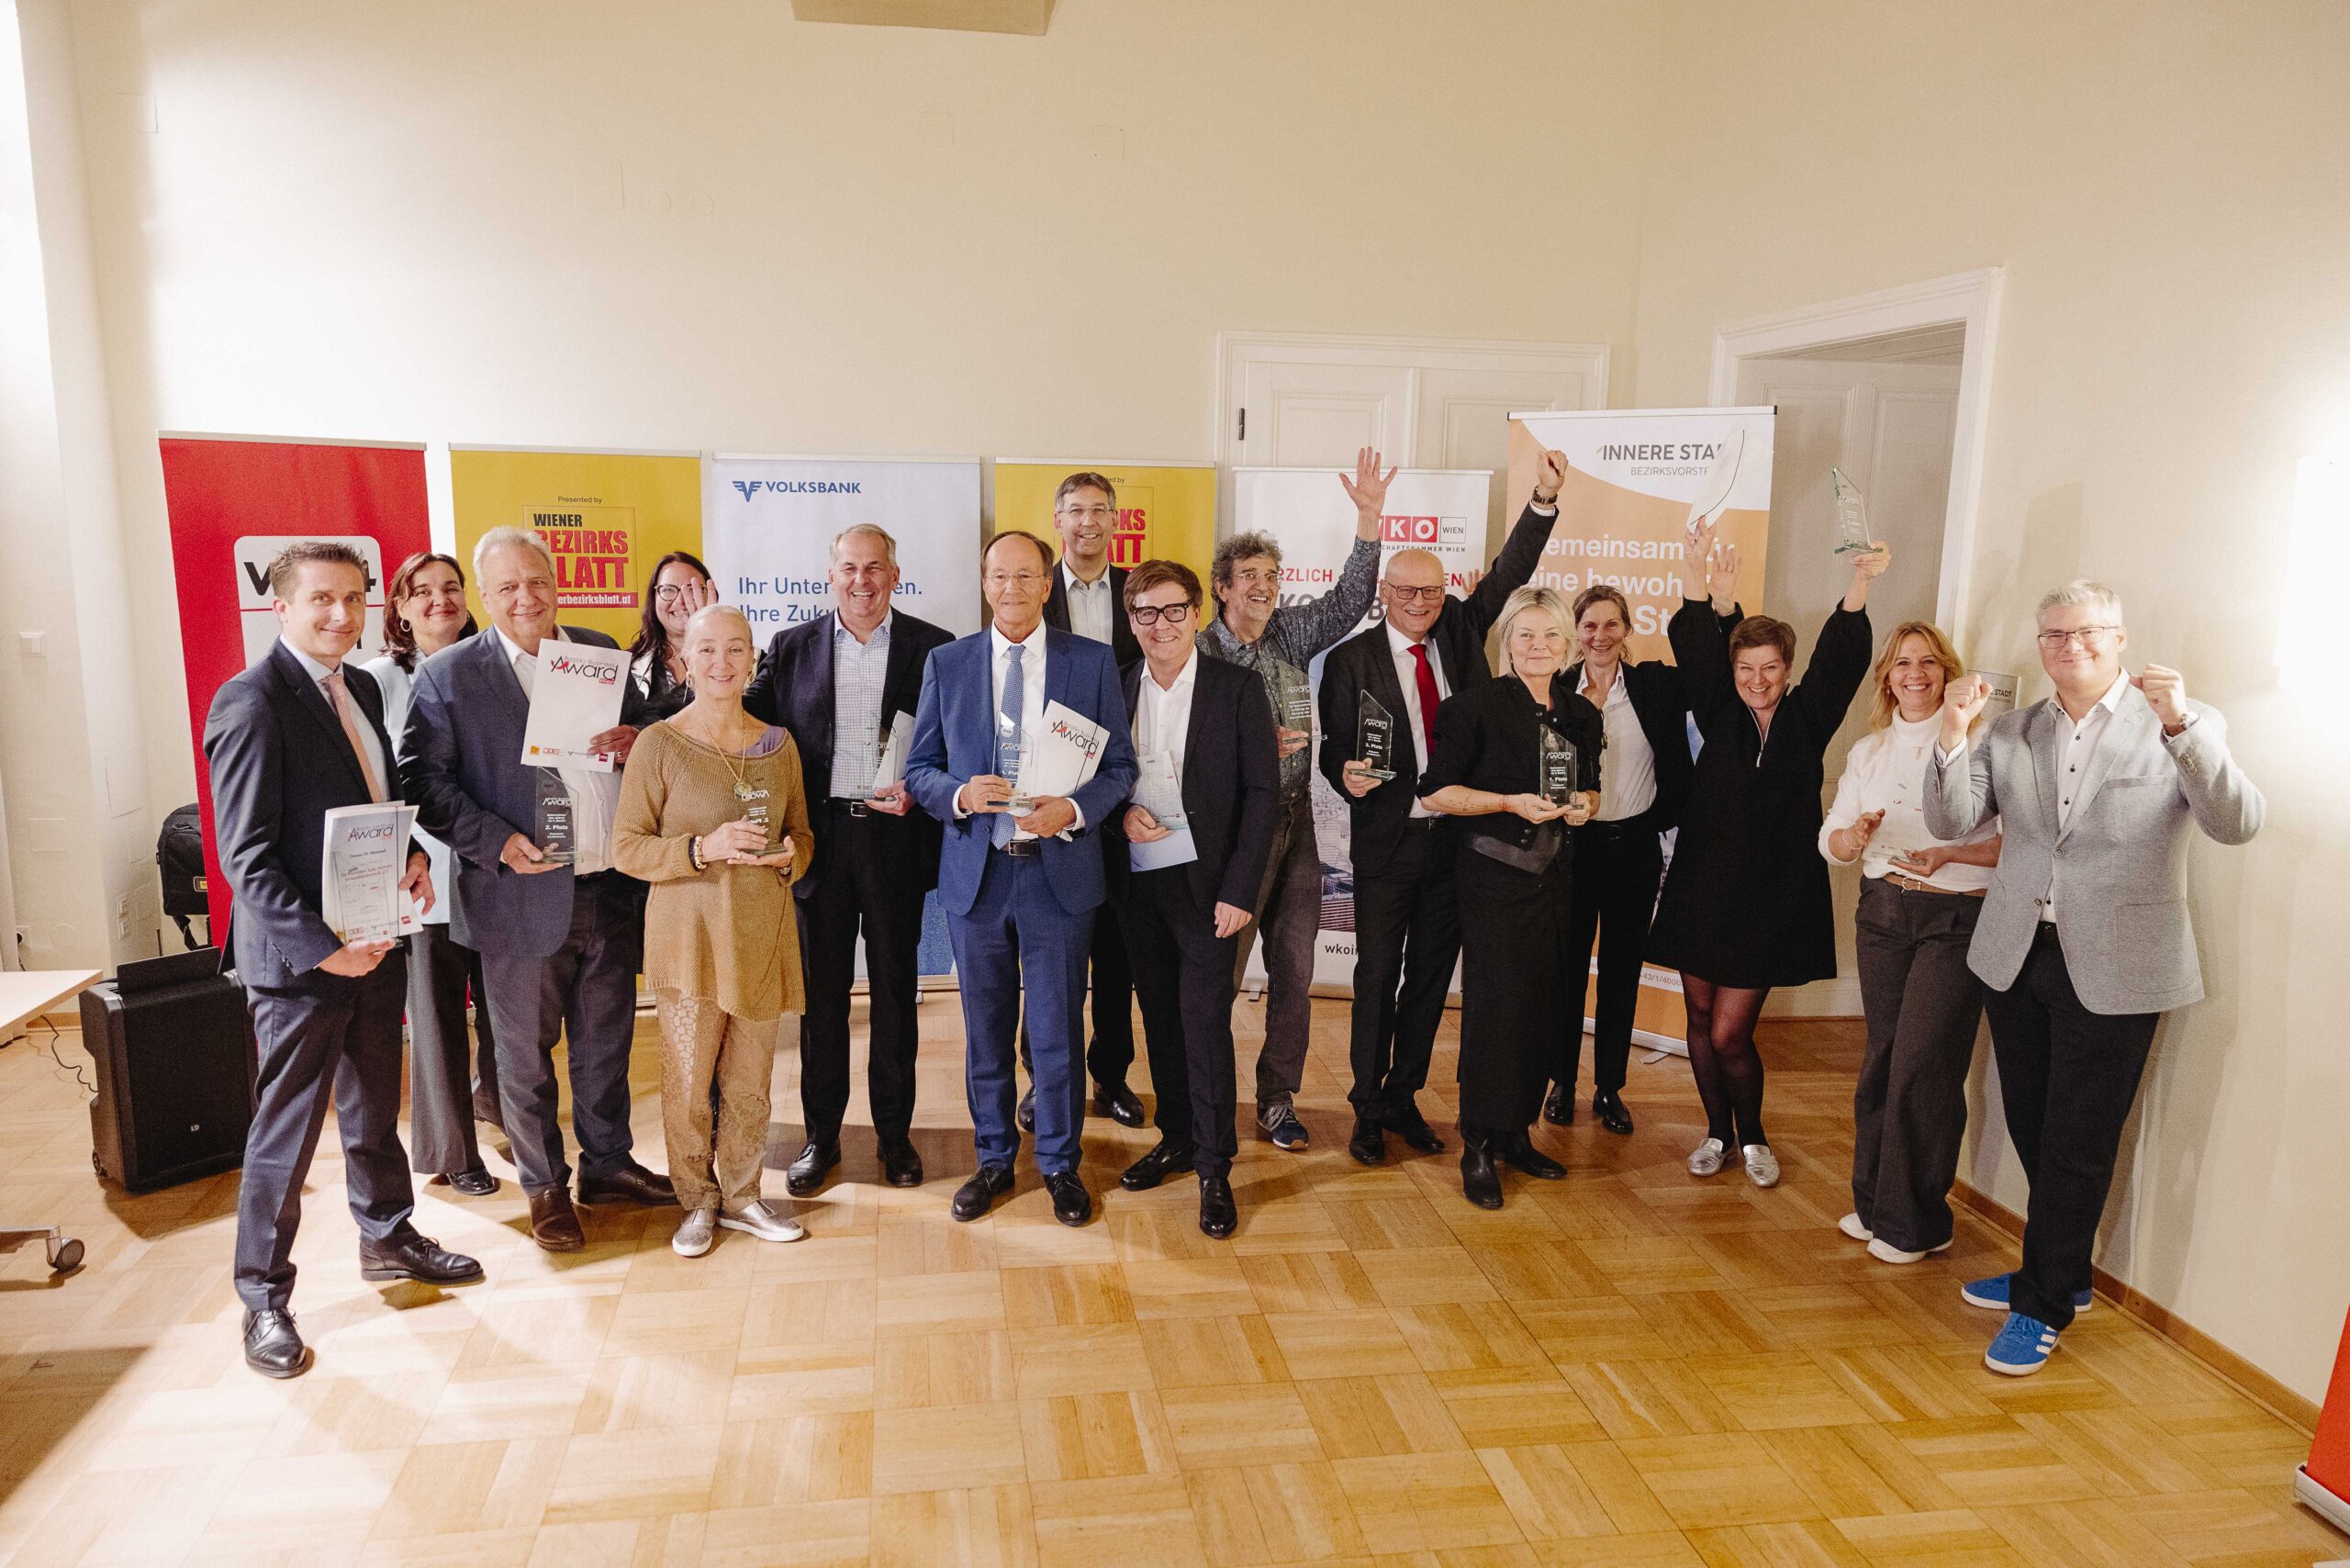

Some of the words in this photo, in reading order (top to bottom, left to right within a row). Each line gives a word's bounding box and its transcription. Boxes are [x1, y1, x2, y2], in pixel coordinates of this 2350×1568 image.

[1603, 444, 1674, 460] INNERE
[1679, 444, 1722, 460] STA
[766, 481, 862, 494] VOLKSBANK
[532, 513, 583, 527] WIENER
[1442, 525, 1464, 534] WIEN
[1545, 533, 1684, 560] emeinsam
[555, 555, 629, 588] LATT
[739, 577, 768, 595] Ihr
[775, 577, 923, 595] Unteren.
[557, 594, 632, 605] erbezirksblatt.at
[551, 655, 619, 682] Award
[1994, 689, 2013, 698] STADT
[1051, 720, 1100, 755] Award
[347, 823, 395, 843] Award
[1325, 943, 1358, 956] wkoi
[1641, 972, 1683, 987] 43/1/4000
[190, 1124, 200, 1132] LD
